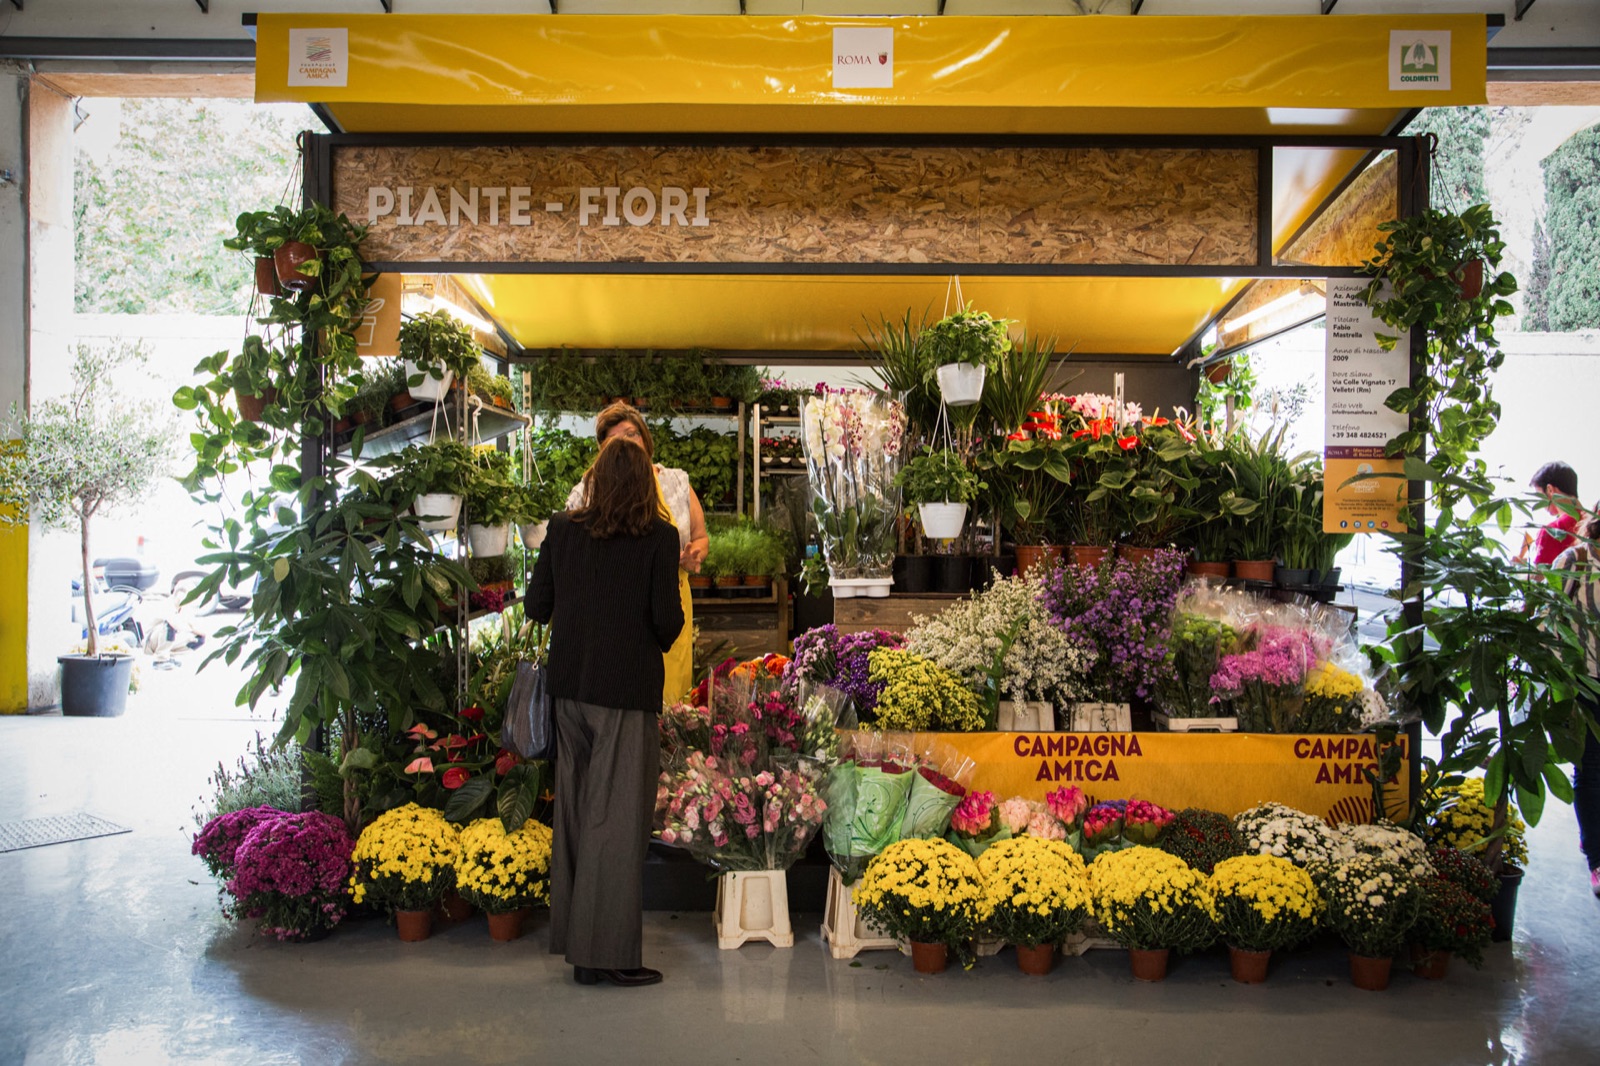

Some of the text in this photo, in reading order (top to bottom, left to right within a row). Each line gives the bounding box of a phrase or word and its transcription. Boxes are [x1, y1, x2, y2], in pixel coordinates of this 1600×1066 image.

[837, 55, 872, 65] ROMA
[368, 187, 710, 227] PIANTE - FIORI
[1333, 284, 1362, 292] Azienda
[1332, 423, 1360, 432] Telefono
[1014, 735, 1142, 757] CAMPAGNA
[1035, 759, 1120, 782] AMICA
